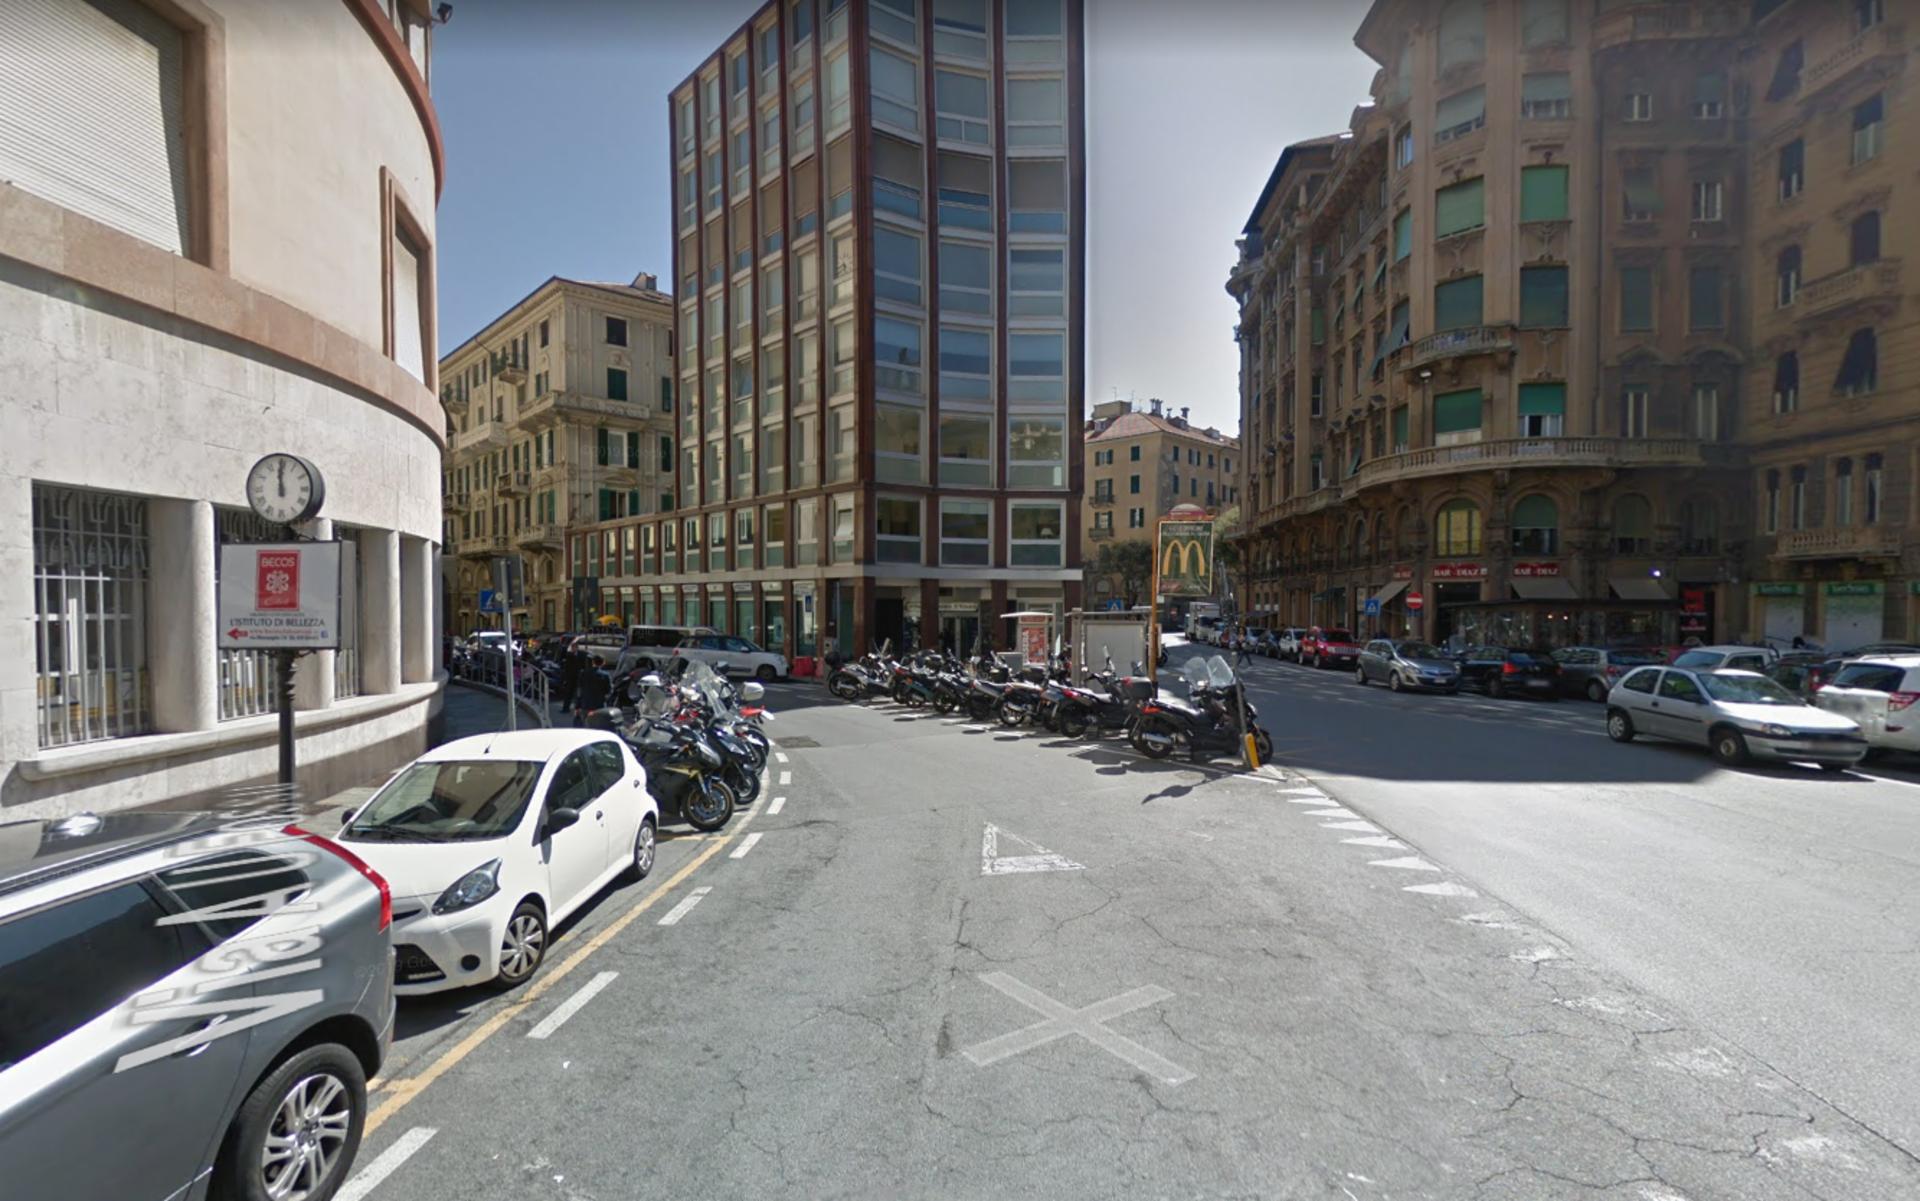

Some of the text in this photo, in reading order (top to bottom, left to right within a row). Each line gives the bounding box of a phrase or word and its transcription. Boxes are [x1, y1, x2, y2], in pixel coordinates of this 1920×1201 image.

[261, 556, 296, 568] BECOS
[230, 617, 325, 627] L'ISTITUTO DI BELLEZZA
